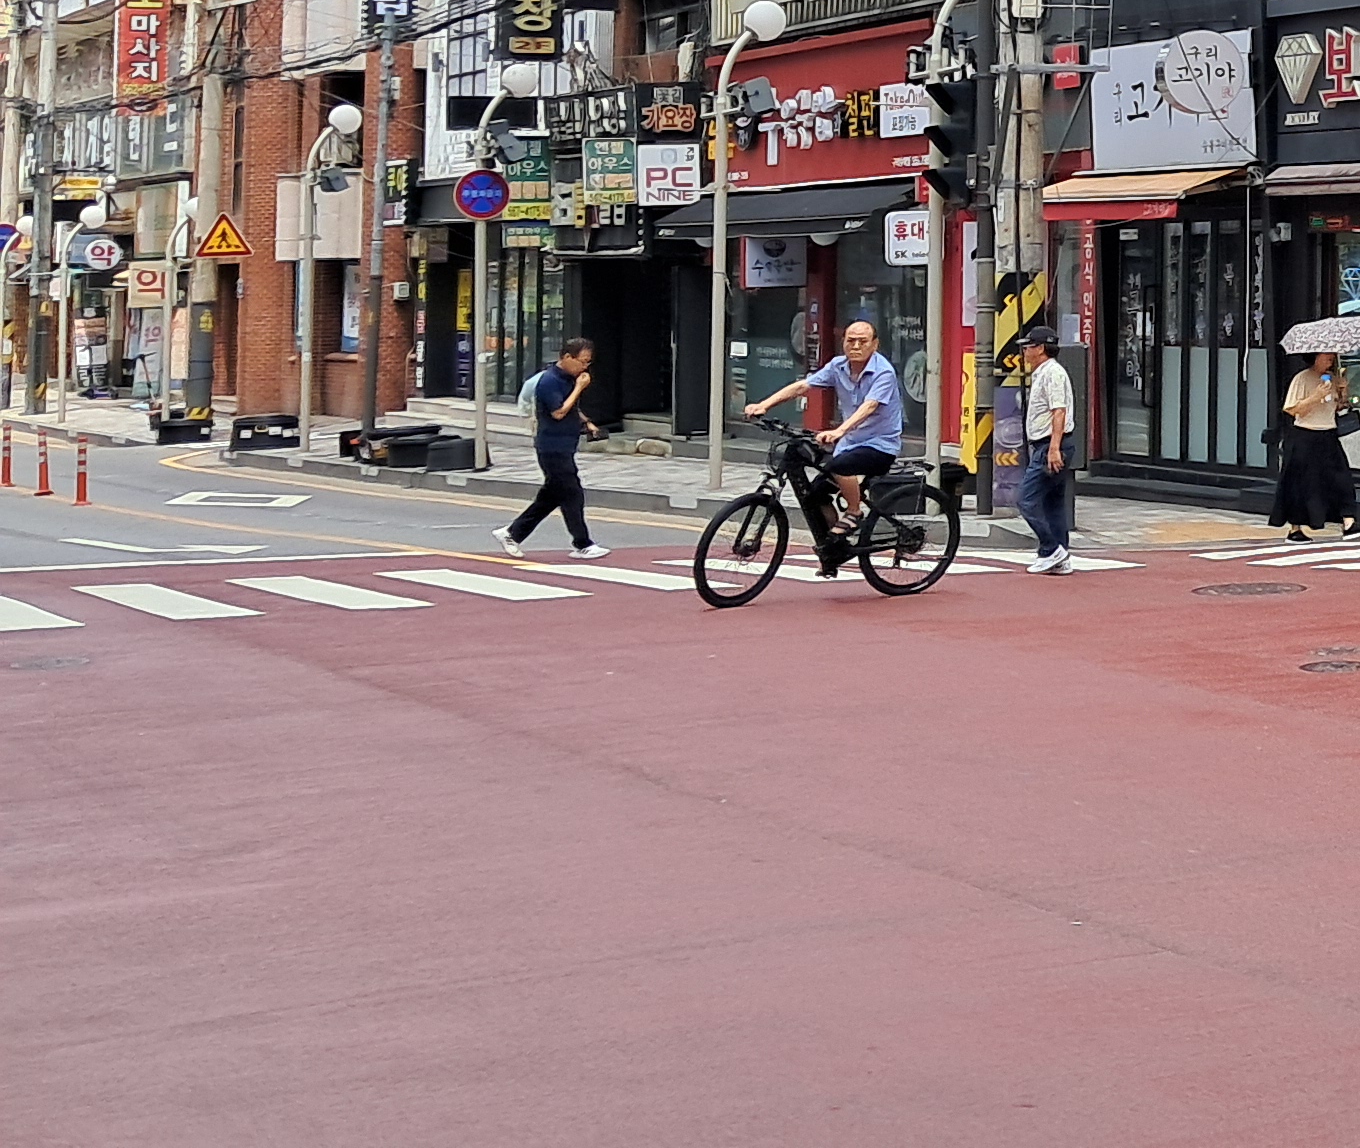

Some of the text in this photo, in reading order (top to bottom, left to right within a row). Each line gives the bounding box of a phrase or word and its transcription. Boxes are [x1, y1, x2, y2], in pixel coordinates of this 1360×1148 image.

[512, 38, 554, 53] 2F
[1189, 44, 1219, 60] 구리
[1171, 61, 1237, 86] 고기야
[641, 104, 696, 132] 가요장
[645, 167, 694, 188] PC
[645, 189, 694, 202] NINE
[90, 244, 116, 267] 약
